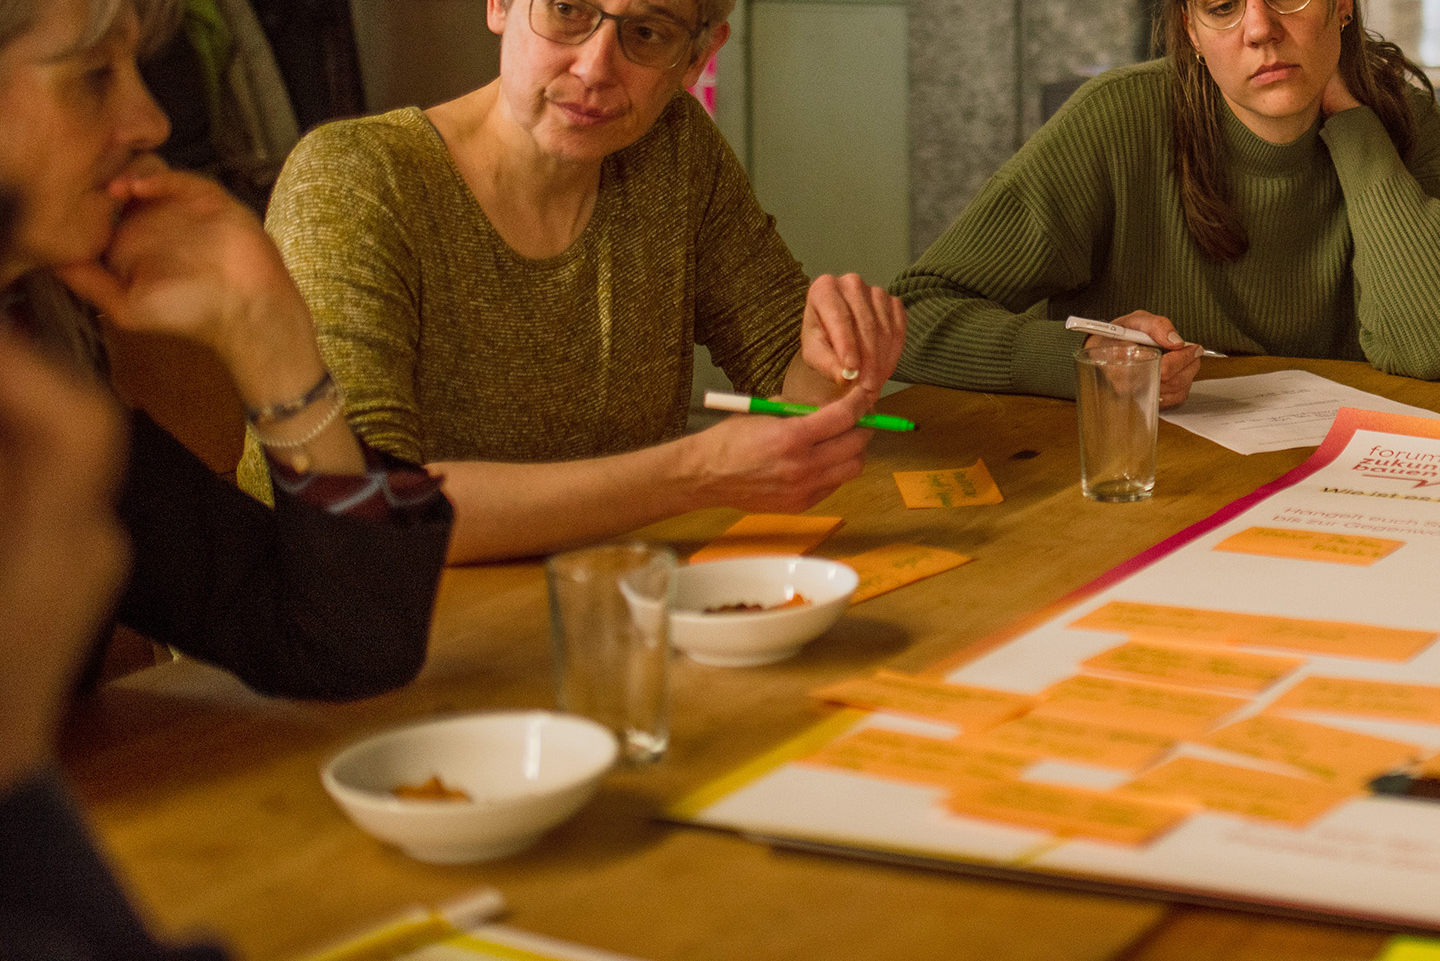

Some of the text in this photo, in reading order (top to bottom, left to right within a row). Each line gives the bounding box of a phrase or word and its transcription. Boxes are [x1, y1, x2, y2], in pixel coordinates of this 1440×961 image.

[1351, 463, 1438, 477] bauen
[1322, 486, 1364, 496] Wie
[1369, 492, 1399, 500] ist
[1404, 494, 1432, 503] es
[1272, 514, 1301, 524] bis
[1306, 518, 1337, 527] zur
[1369, 513, 1418, 526] euch
